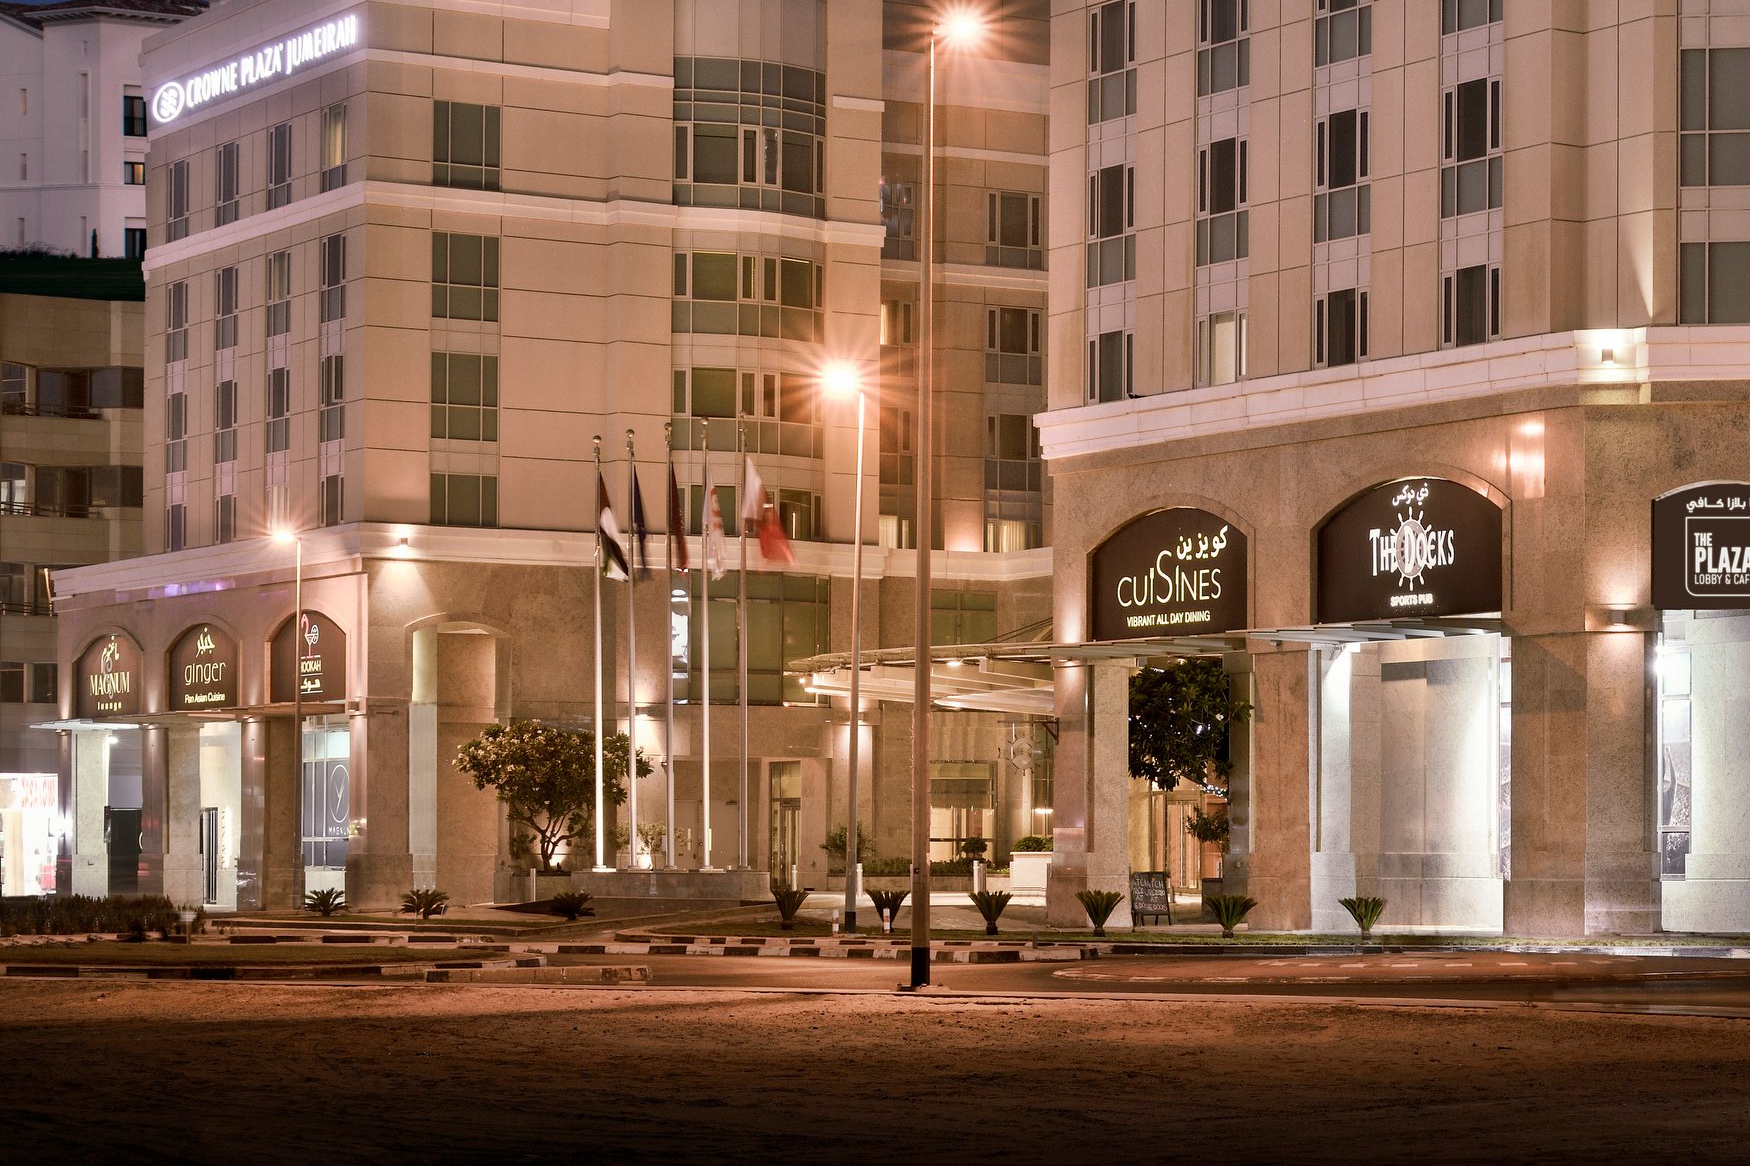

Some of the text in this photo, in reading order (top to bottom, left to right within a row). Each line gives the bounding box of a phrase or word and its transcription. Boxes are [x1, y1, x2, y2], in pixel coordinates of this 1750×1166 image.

[186, 14, 357, 108] CROWNE PLAZA JUMEIRAH
[1727, 497, 1746, 510] بلازا
[1694, 532, 1713, 547] THE
[1117, 550, 1222, 607] CUISINES
[1694, 574, 1722, 585] LOBBY
[1725, 574, 1732, 585] &
[1390, 593, 1433, 607] SPORTS PUB
[1126, 610, 1211, 627] VIBRANT ALL DAY DINING
[184, 662, 226, 686] ginger
[89, 671, 130, 696] MAGNUM
[185, 692, 226, 704] Pan Asian Cuisine
[97, 702, 122, 712] lounge
